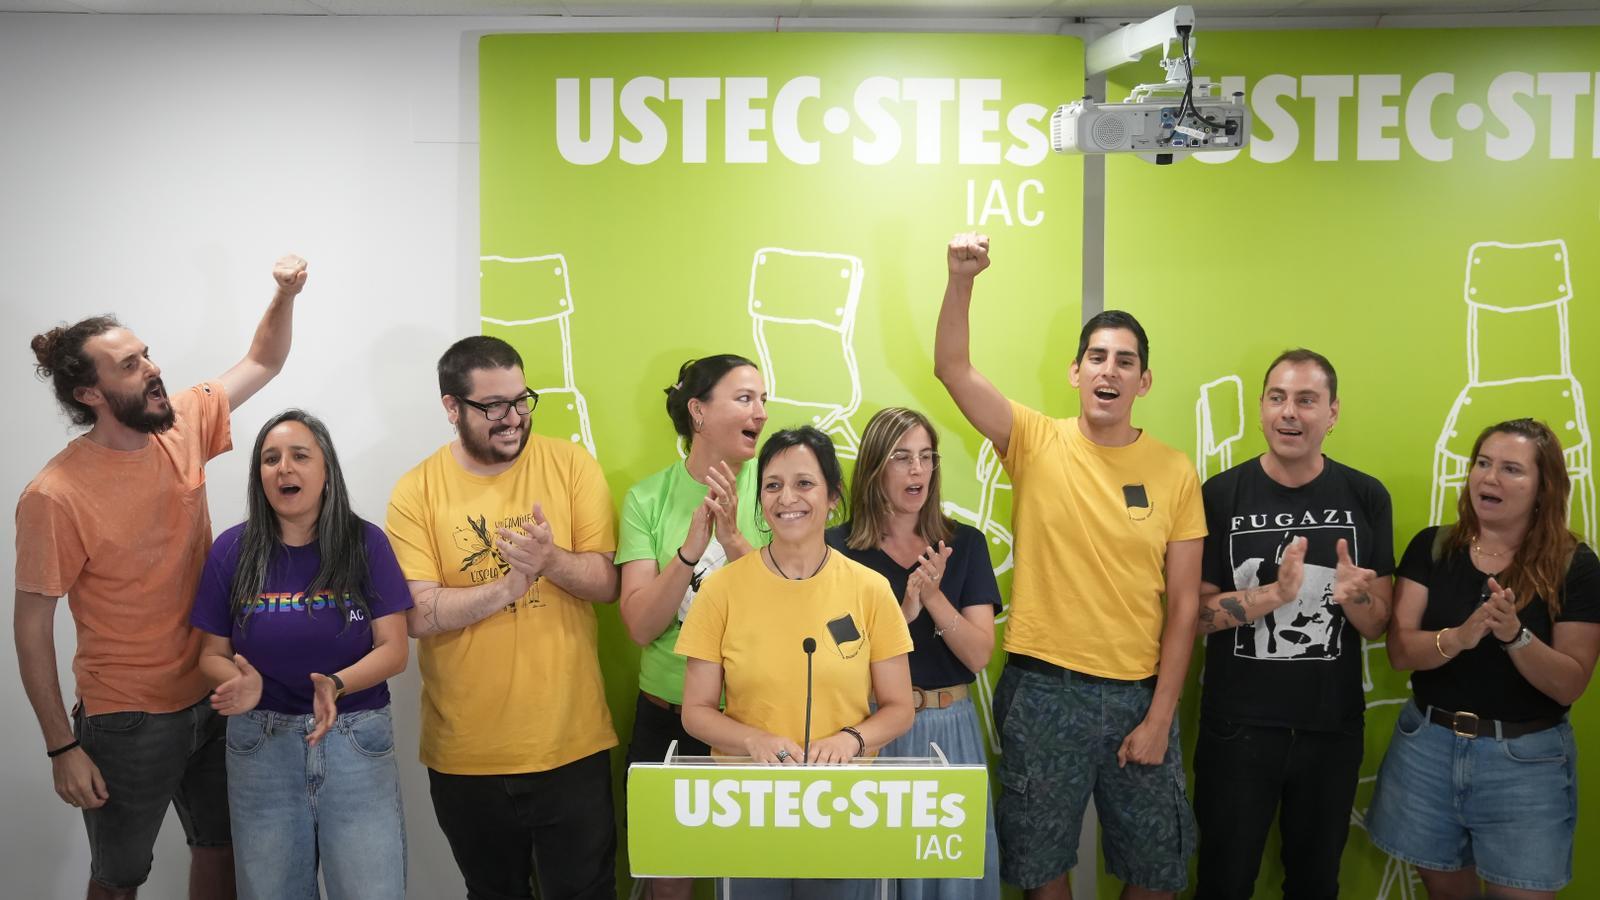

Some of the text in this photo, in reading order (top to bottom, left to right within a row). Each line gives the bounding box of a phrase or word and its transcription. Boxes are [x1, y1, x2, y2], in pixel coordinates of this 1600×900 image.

[1191, 71, 1600, 164] STEC·ST
[966, 179, 1045, 227] IAC
[1230, 509, 1355, 531] FUGAZI
[349, 608, 364, 622] AC
[916, 834, 963, 861] IAC
